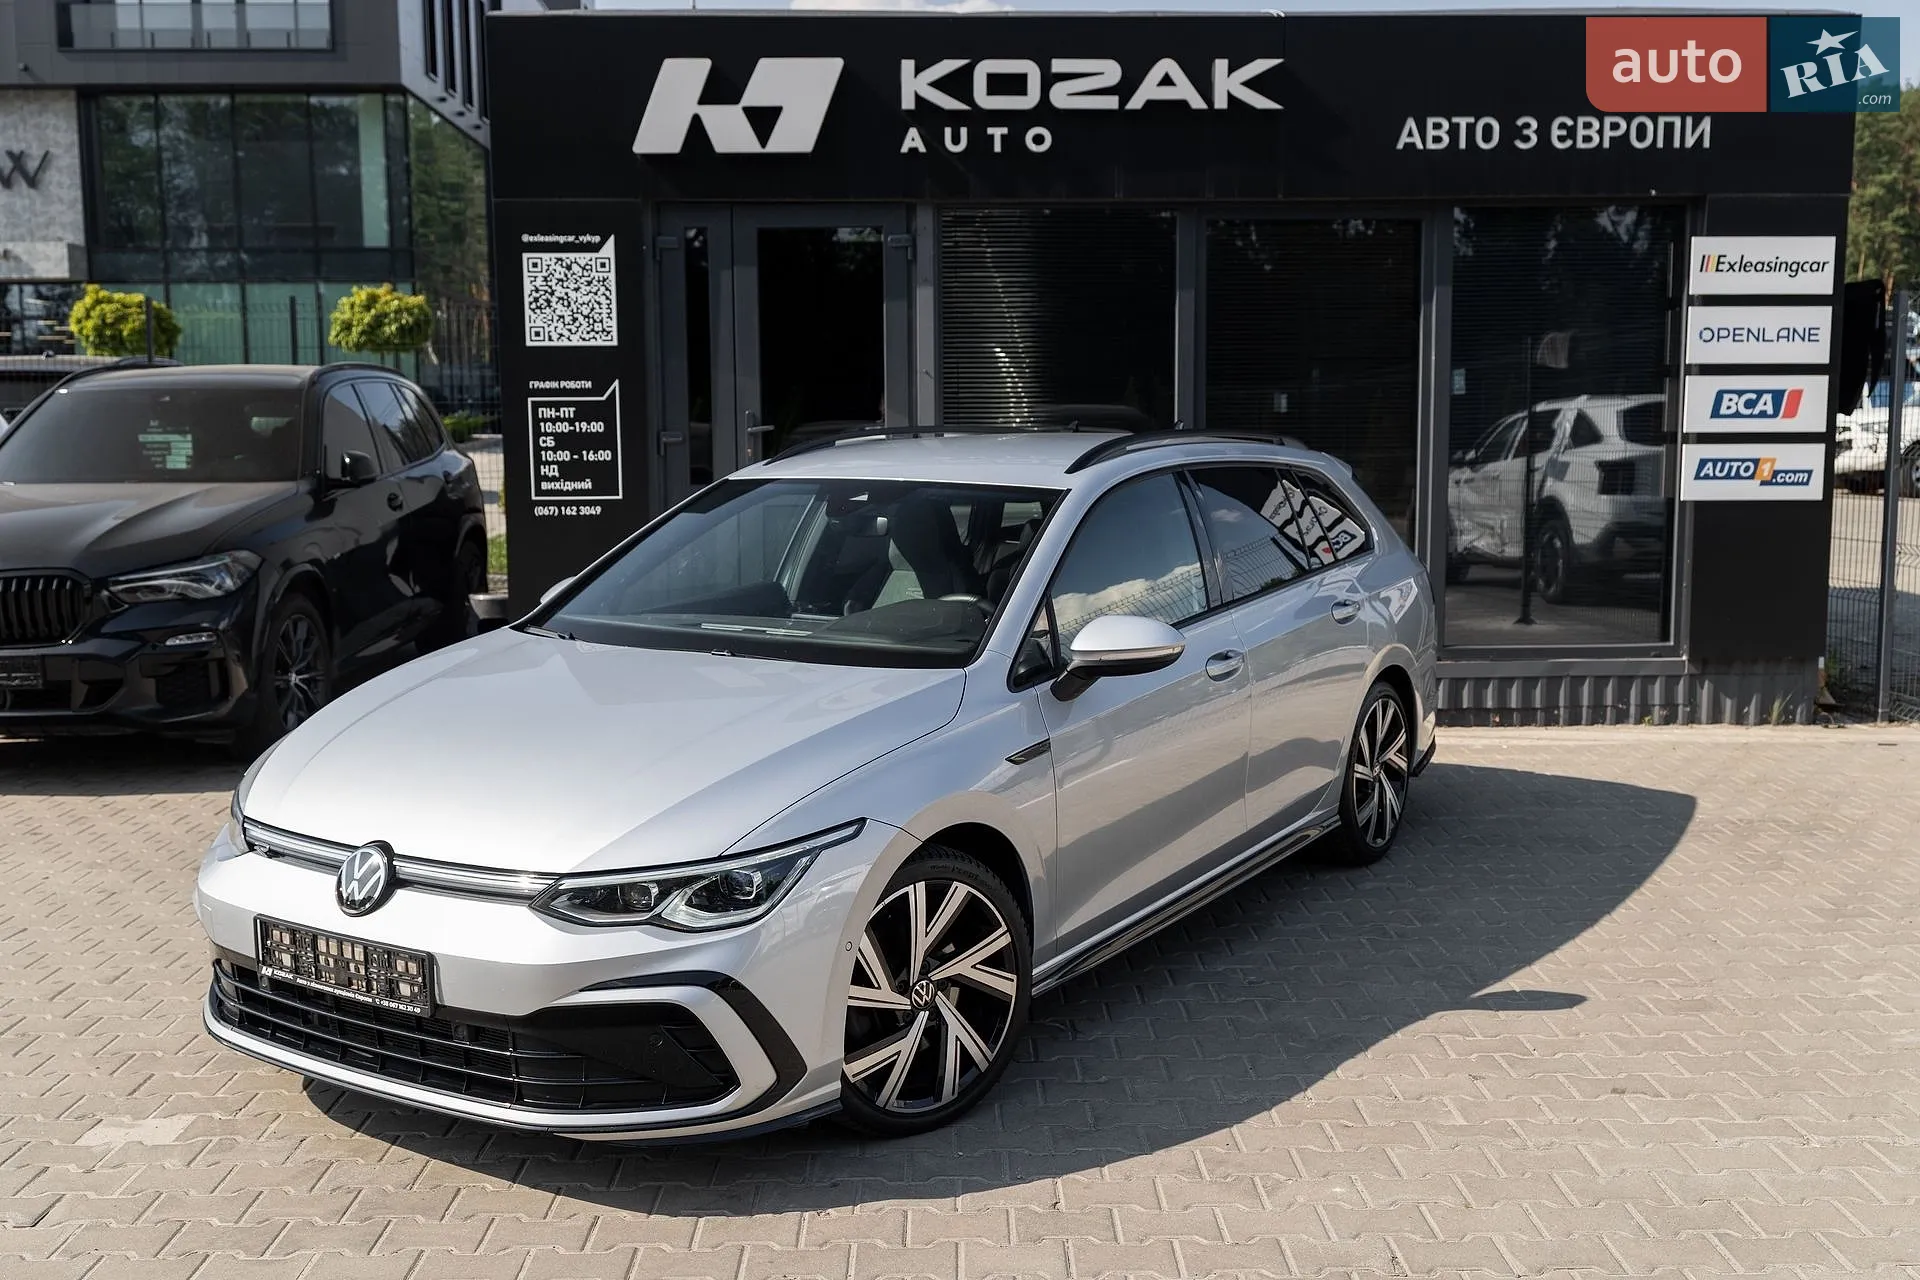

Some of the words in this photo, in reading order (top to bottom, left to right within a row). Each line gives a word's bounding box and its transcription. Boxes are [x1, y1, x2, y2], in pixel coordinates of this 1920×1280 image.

[901, 58, 1285, 110] KOZAK
[1396, 116, 1500, 150] АВТО
[1550, 115, 1712, 150] ЄВРОПИ
[900, 126, 1053, 153] AUTO
[1715, 254, 1830, 278] Exleasingcar
[1699, 326, 1821, 343] OPENLANE
[529, 380, 559, 389] ГРАФІК
[560, 380, 592, 389] РОБОТИ
[1719, 392, 1774, 415] BCA
[538, 407, 576, 419] ПН-ПТ
[539, 421, 605, 433] 10:00-19:00
[539, 436, 556, 448] СБ
[540, 450, 571, 461] 10:00
[582, 450, 612, 461] 16:00
[540, 464, 559, 478] НД
[540, 479, 593, 491] вихідний
[534, 505, 559, 517] (067)
[560, 505, 577, 516] 162
[579, 505, 602, 516] 3049
